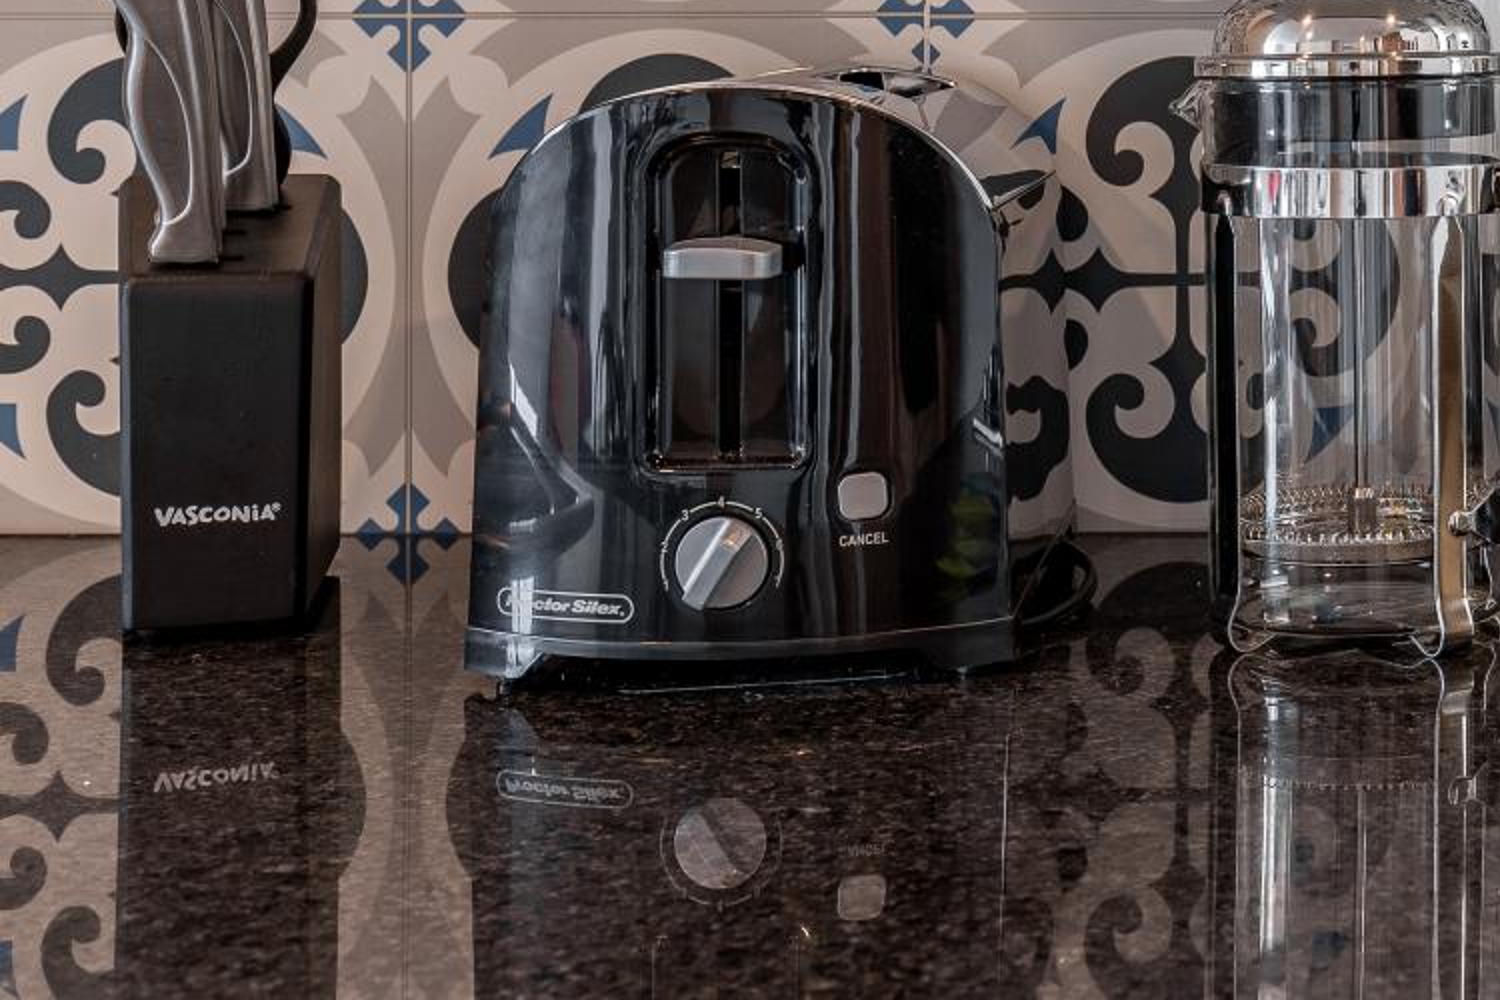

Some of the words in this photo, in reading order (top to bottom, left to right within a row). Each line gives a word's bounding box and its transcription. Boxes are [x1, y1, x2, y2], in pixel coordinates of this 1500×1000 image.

[718, 496, 726, 509] 4
[681, 508, 689, 521] 3
[754, 507, 763, 519] 5
[838, 532, 890, 548] CANCEL
